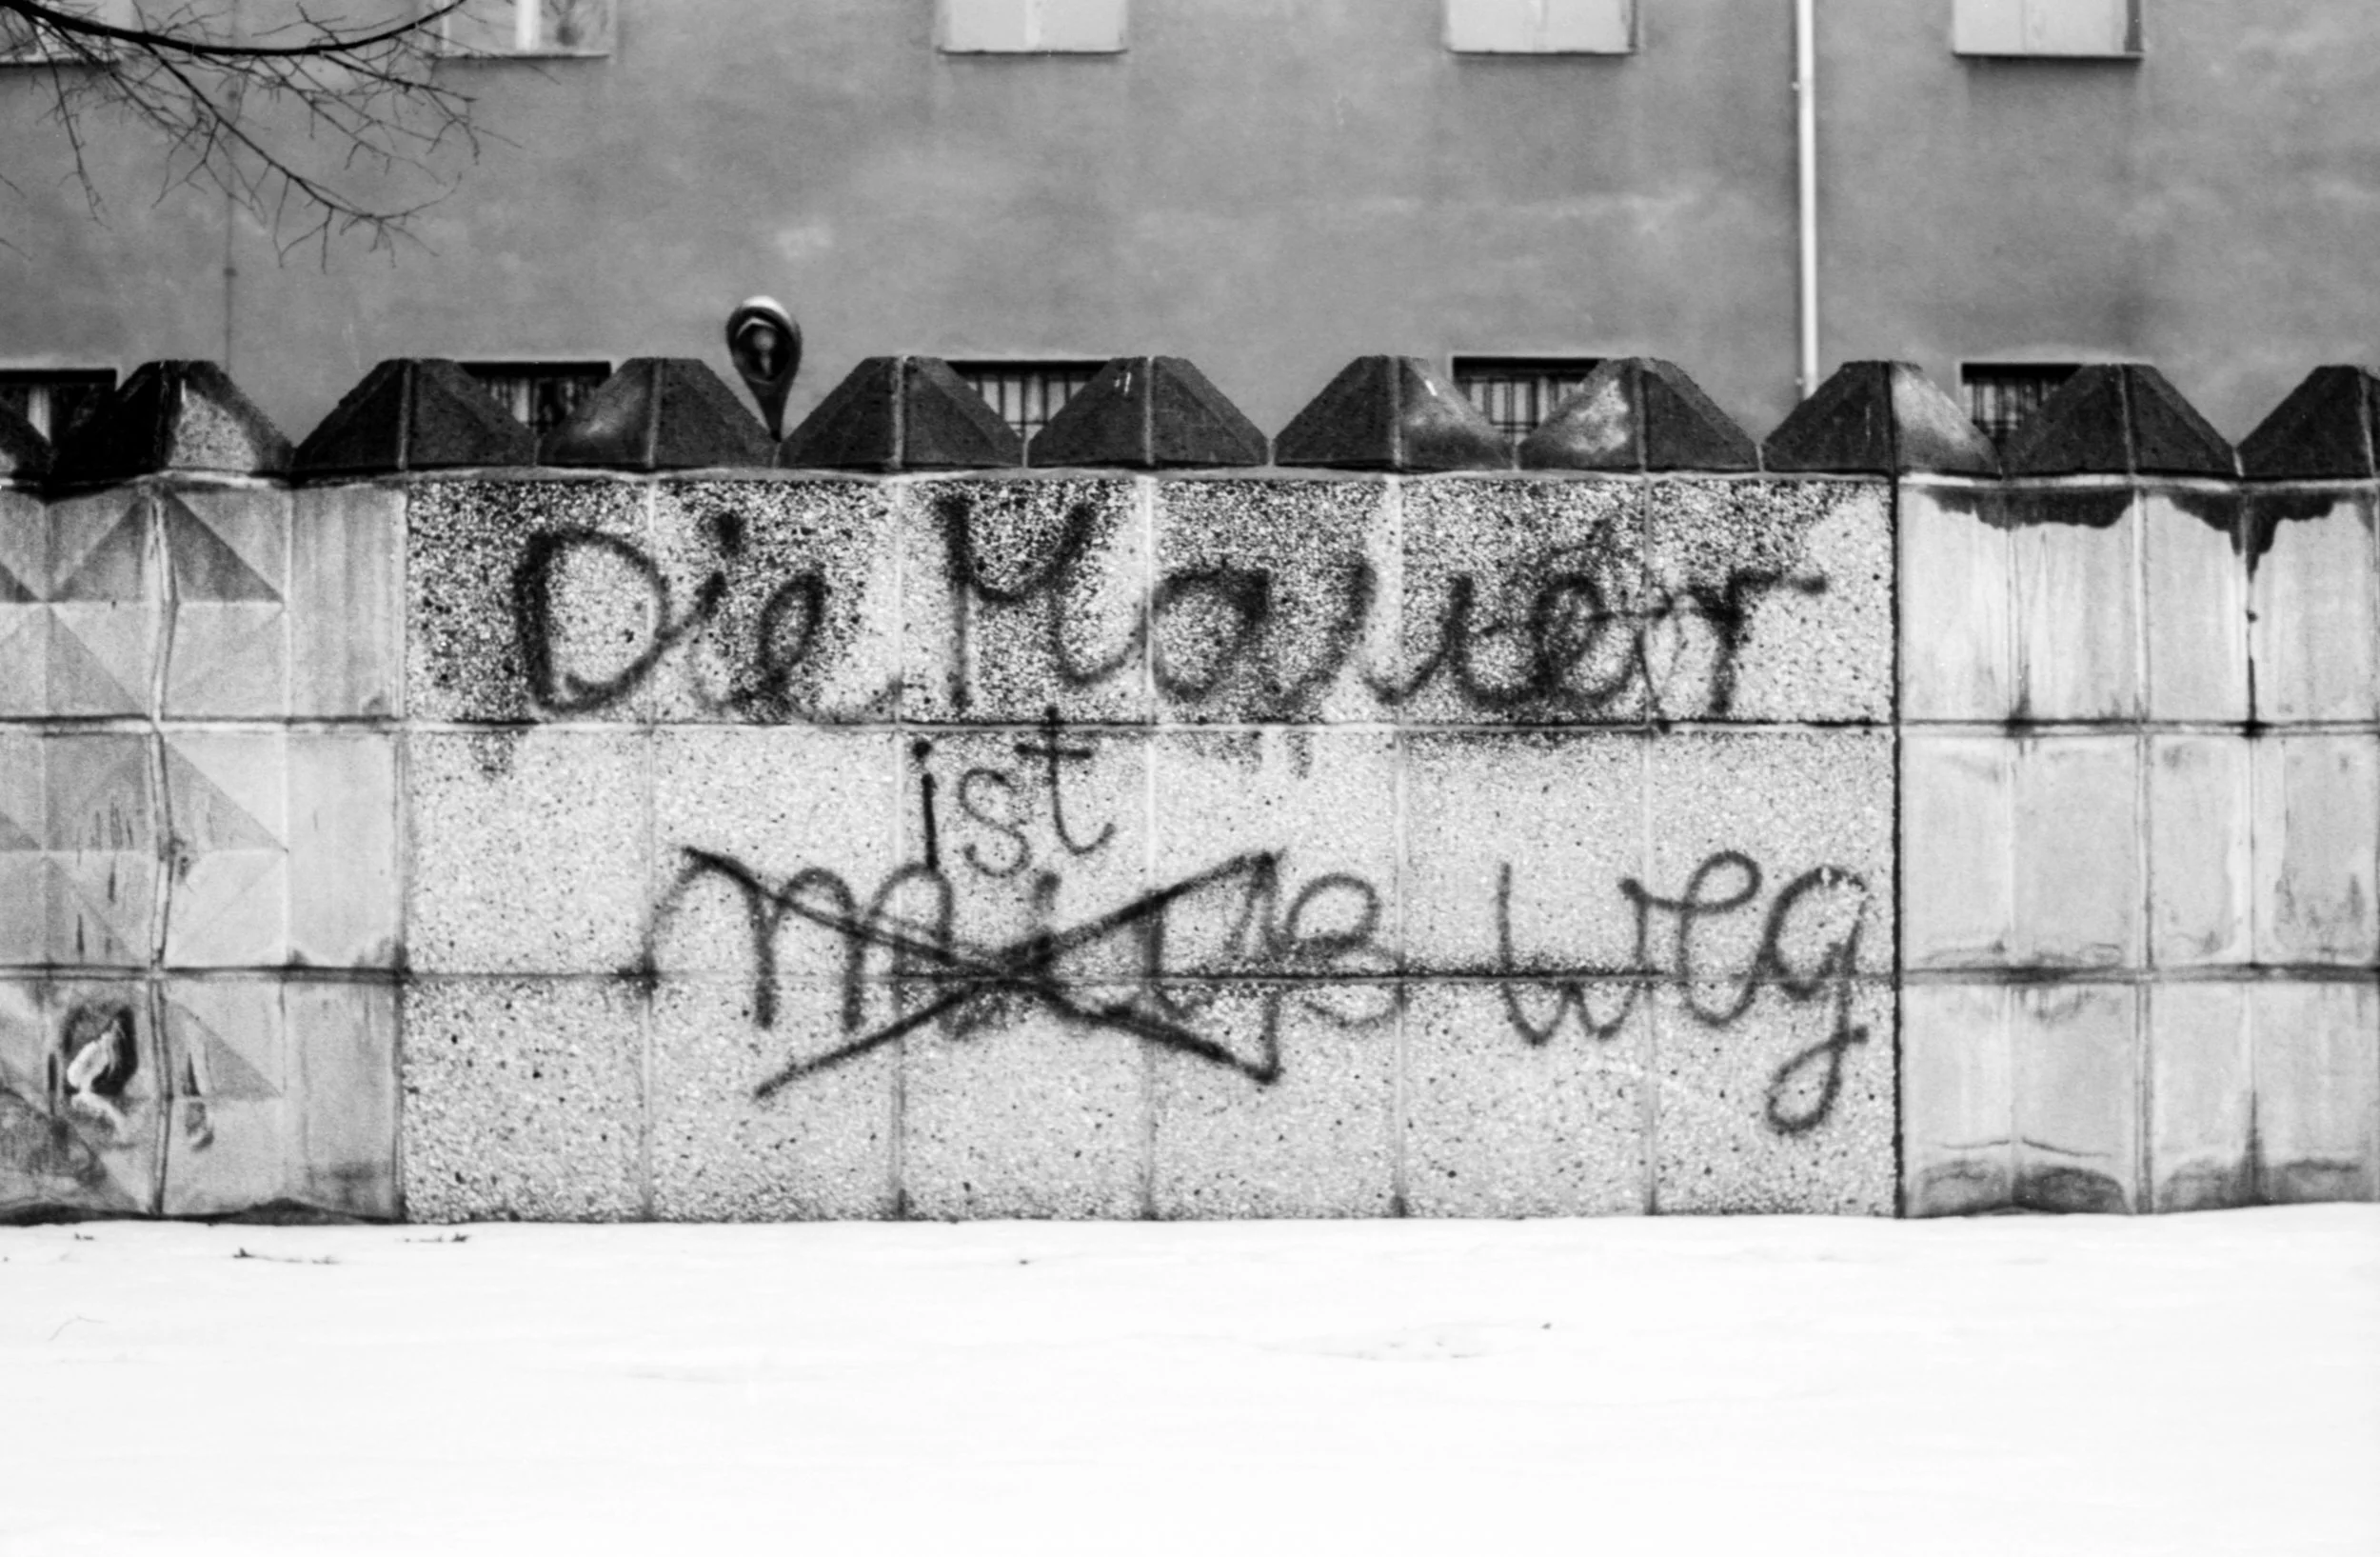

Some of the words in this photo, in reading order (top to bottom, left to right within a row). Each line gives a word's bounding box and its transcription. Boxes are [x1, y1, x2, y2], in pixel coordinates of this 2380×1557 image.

[514, 509, 902, 722] Die
[935, 491, 1828, 722] Mauer
[910, 705, 1118, 878] ist
[1497, 849, 1870, 1135] weg
